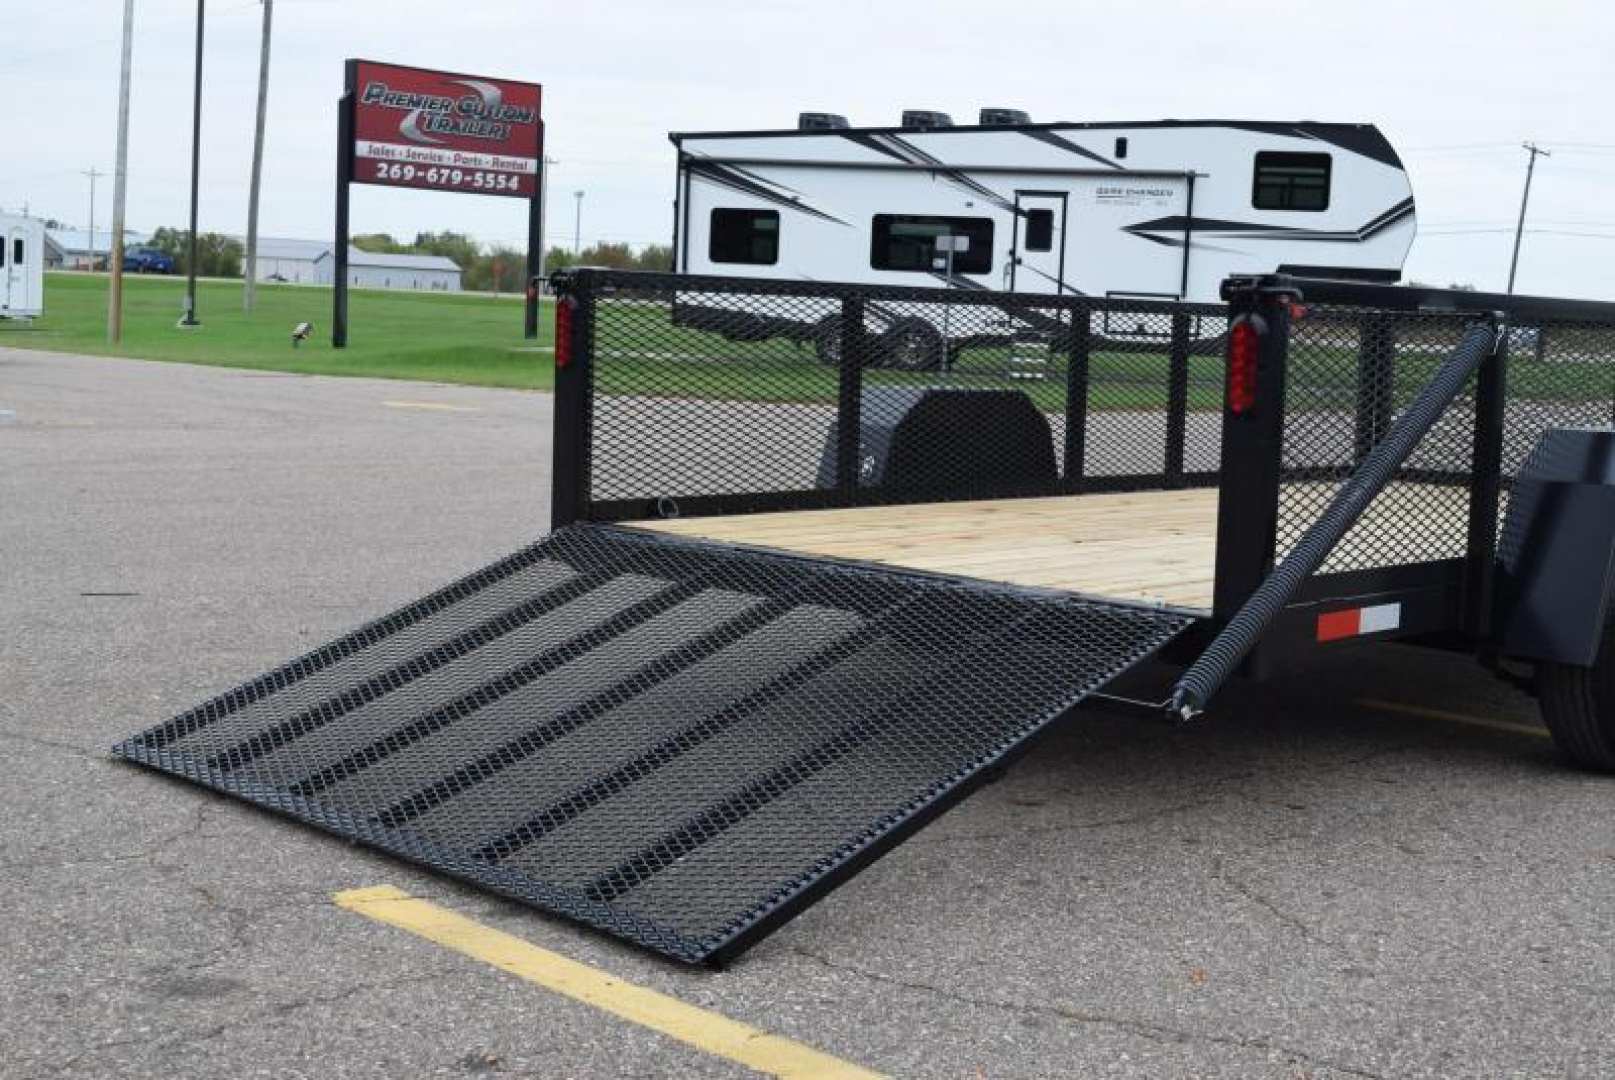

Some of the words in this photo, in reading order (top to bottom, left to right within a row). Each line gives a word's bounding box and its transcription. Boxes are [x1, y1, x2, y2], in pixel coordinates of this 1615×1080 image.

[361, 81, 454, 113] PREMIER
[367, 145, 397, 158] Sales
[406, 148, 445, 162] Service
[454, 153, 482, 166] Parts
[492, 157, 528, 171] Rental
[377, 163, 520, 191] 269-679-5554
